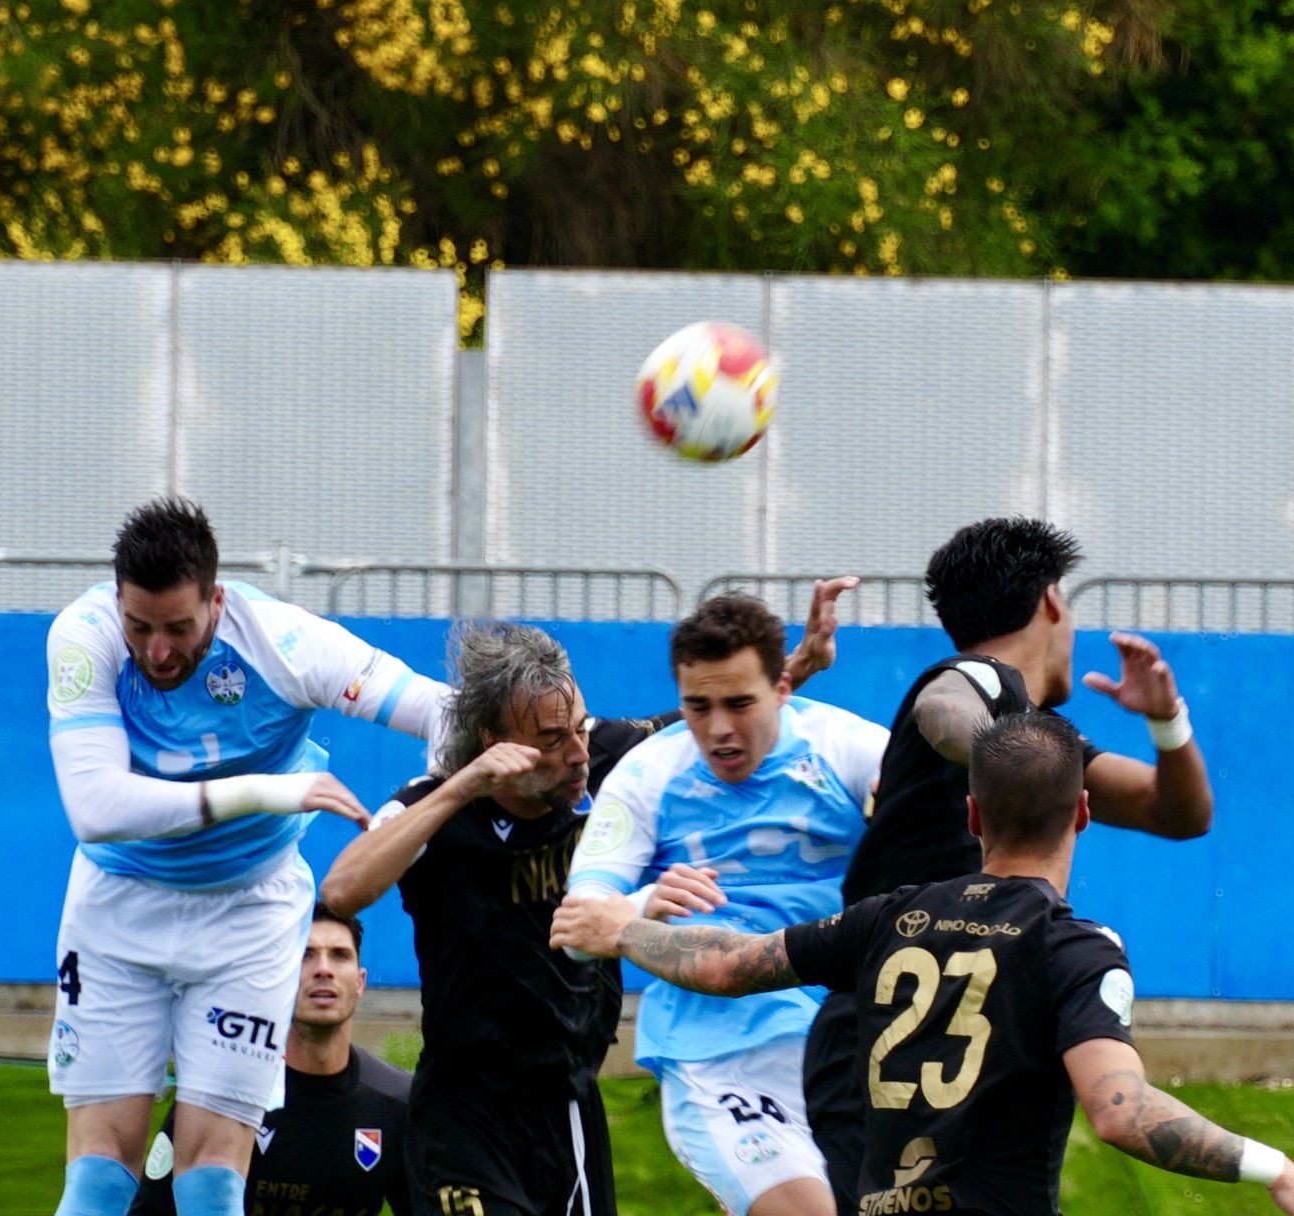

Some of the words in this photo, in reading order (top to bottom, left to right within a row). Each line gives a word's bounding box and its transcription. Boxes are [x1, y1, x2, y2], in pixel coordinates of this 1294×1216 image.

[58, 950, 81, 1005] 4
[217, 1011, 278, 1050] GTL
[868, 946, 997, 1110] 23
